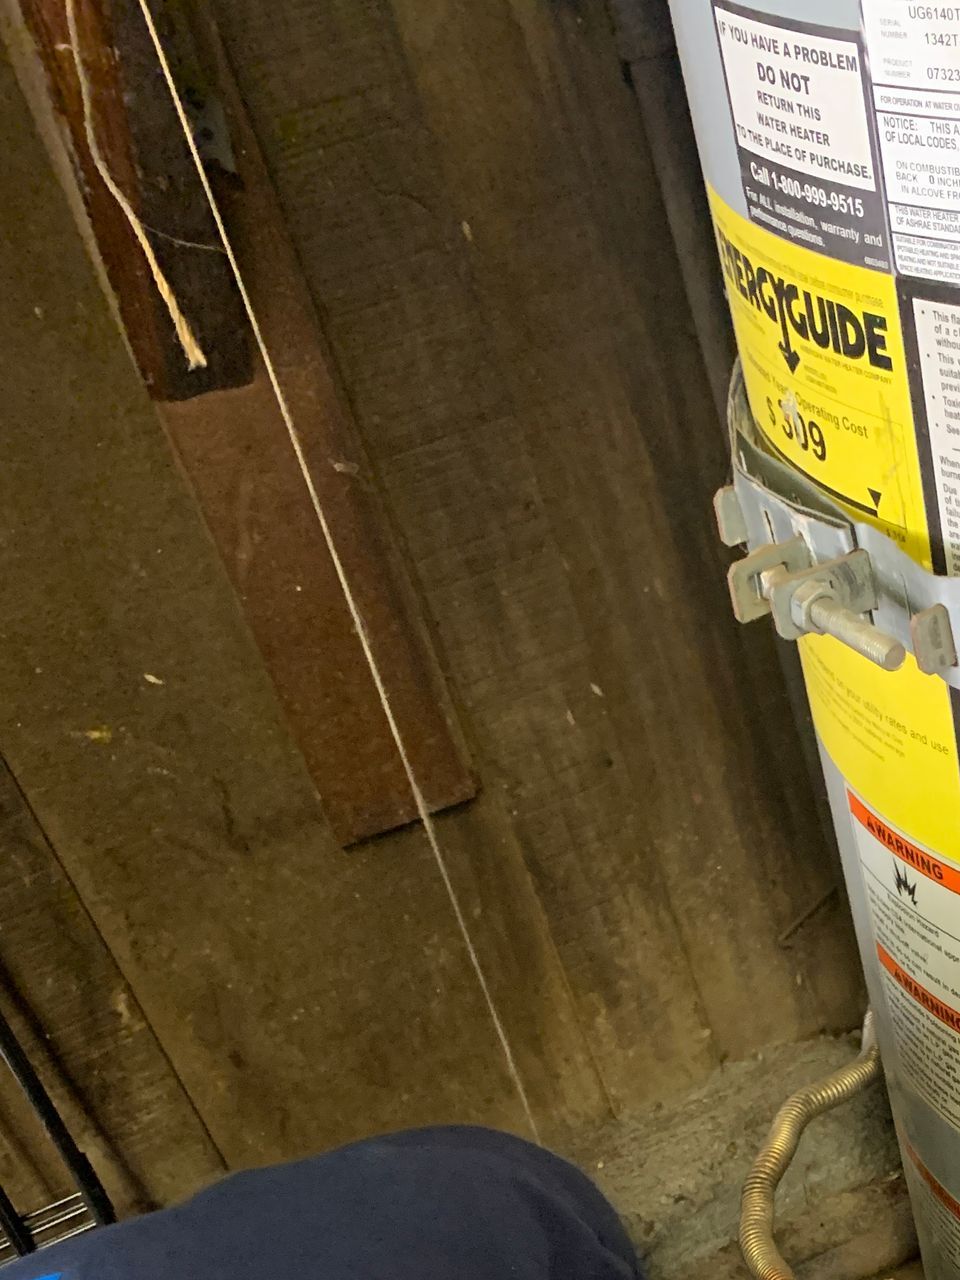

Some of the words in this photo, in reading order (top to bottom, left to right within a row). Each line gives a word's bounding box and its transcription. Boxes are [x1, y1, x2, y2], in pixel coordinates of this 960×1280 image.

[719, 20, 725, 36] IF
[730, 26, 748, 45] YOU
[751, 33, 779, 55] HAVE
[784, 42, 791, 58] A
[794, 45, 857, 72] PROBLEM
[757, 62, 776, 85] DO
[780, 70, 810, 95] NOT
[757, 90, 794, 114] RETURN
[797, 103, 821, 121] THIS
[883, 116, 918, 132] NOTICE:
[930, 121, 951, 135] THIS
[757, 112, 787, 134] WATER
[790, 125, 830, 147] HEATER
[737, 124, 747, 139] TO
[748, 129, 763, 146] THE
[765, 136, 793, 158] PLACE
[795, 147, 807, 163] OF
[810, 152, 872, 180] PURCHASE.
[751, 161, 770, 187] Call
[771, 171, 864, 218] 1-800-999-9515
[821, 221, 860, 243] warranty
[864, 232, 882, 247] and
[717, 228, 893, 372] ENERGYGUIDE
[933, 310, 949, 323] This
[795, 392, 840, 427] Operating
[841, 417, 868, 438] Cost
[885, 715, 907, 734] rates
[910, 730, 928, 745] and
[931, 740, 949, 755] use
[875, 824, 945, 881] WARNING
